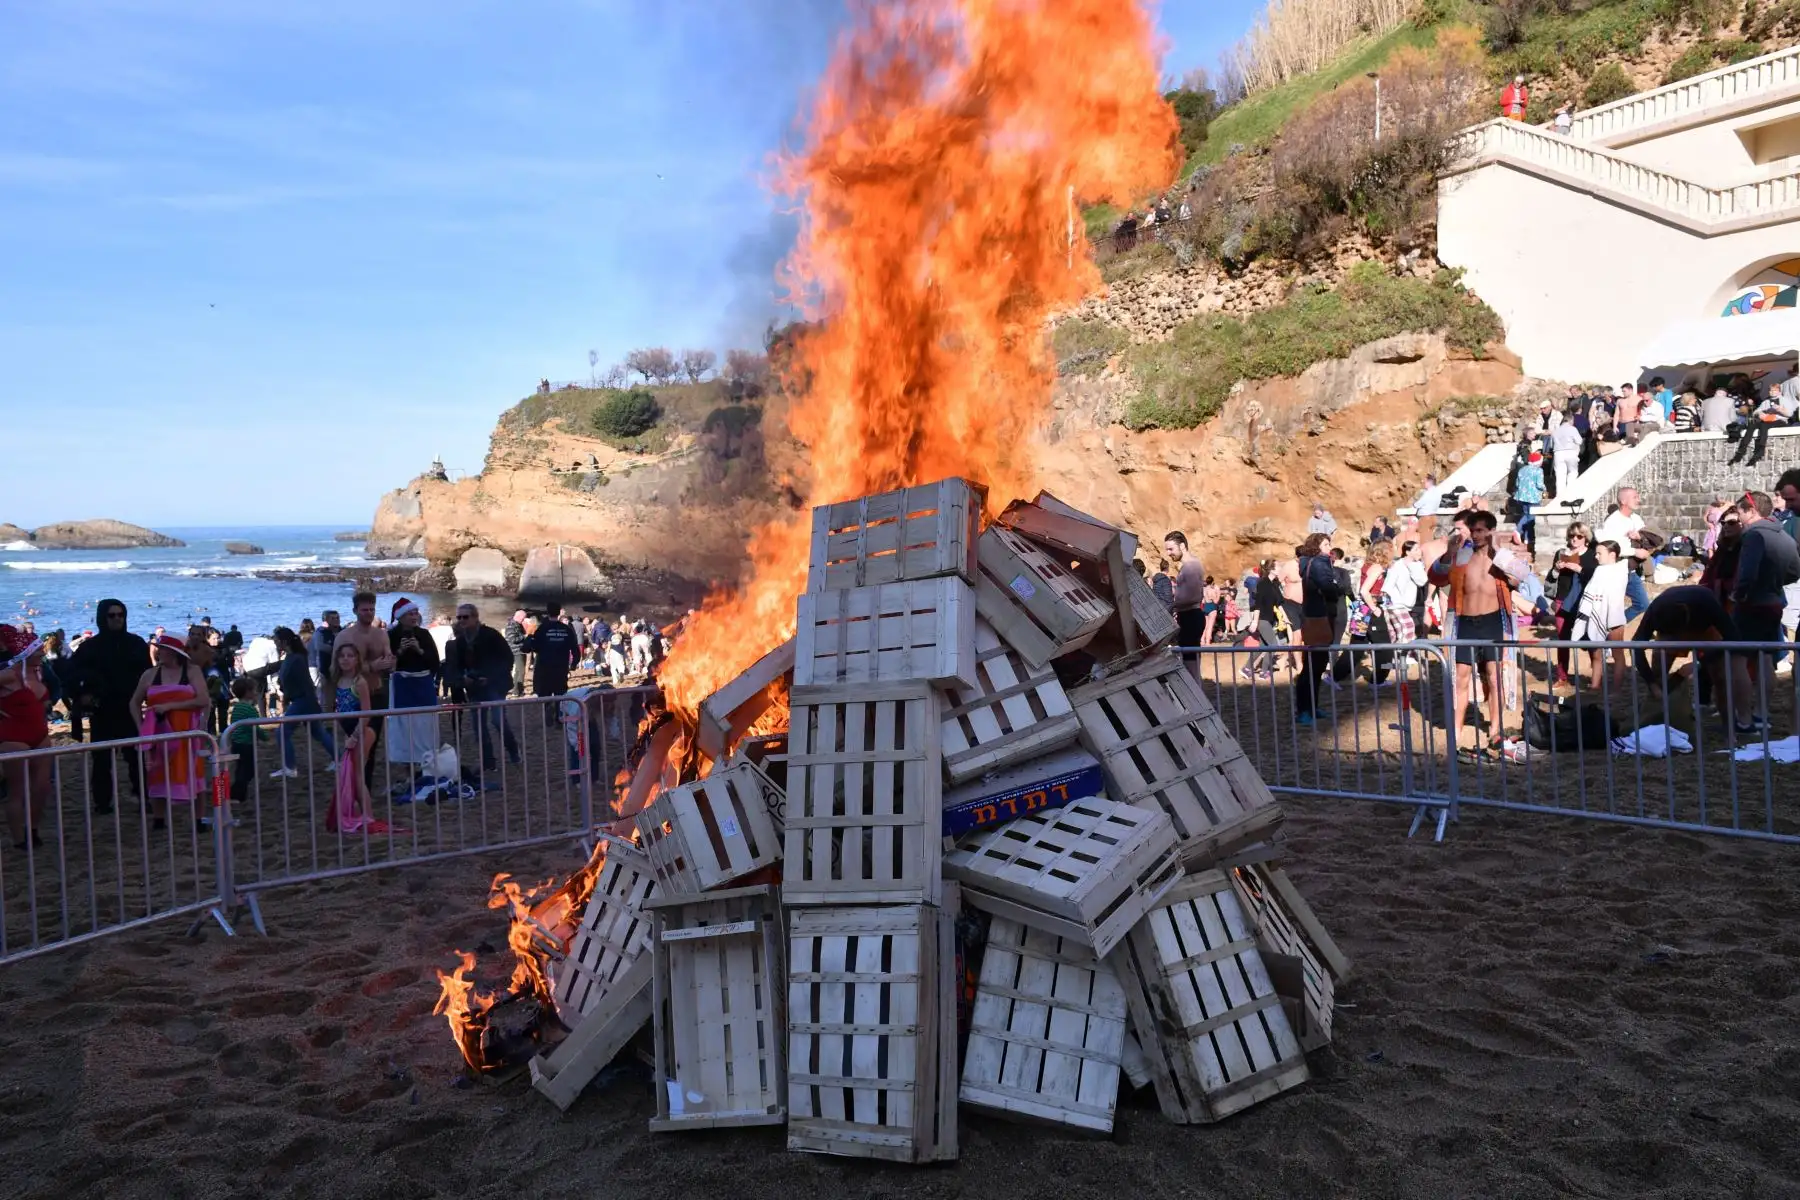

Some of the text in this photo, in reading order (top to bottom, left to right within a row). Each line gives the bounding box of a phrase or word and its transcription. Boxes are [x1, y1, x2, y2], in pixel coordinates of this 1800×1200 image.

[1052, 776, 1080, 786] SAVEUR
[958, 800, 994, 812] COULEUR
[973, 783, 1069, 824] LULU
